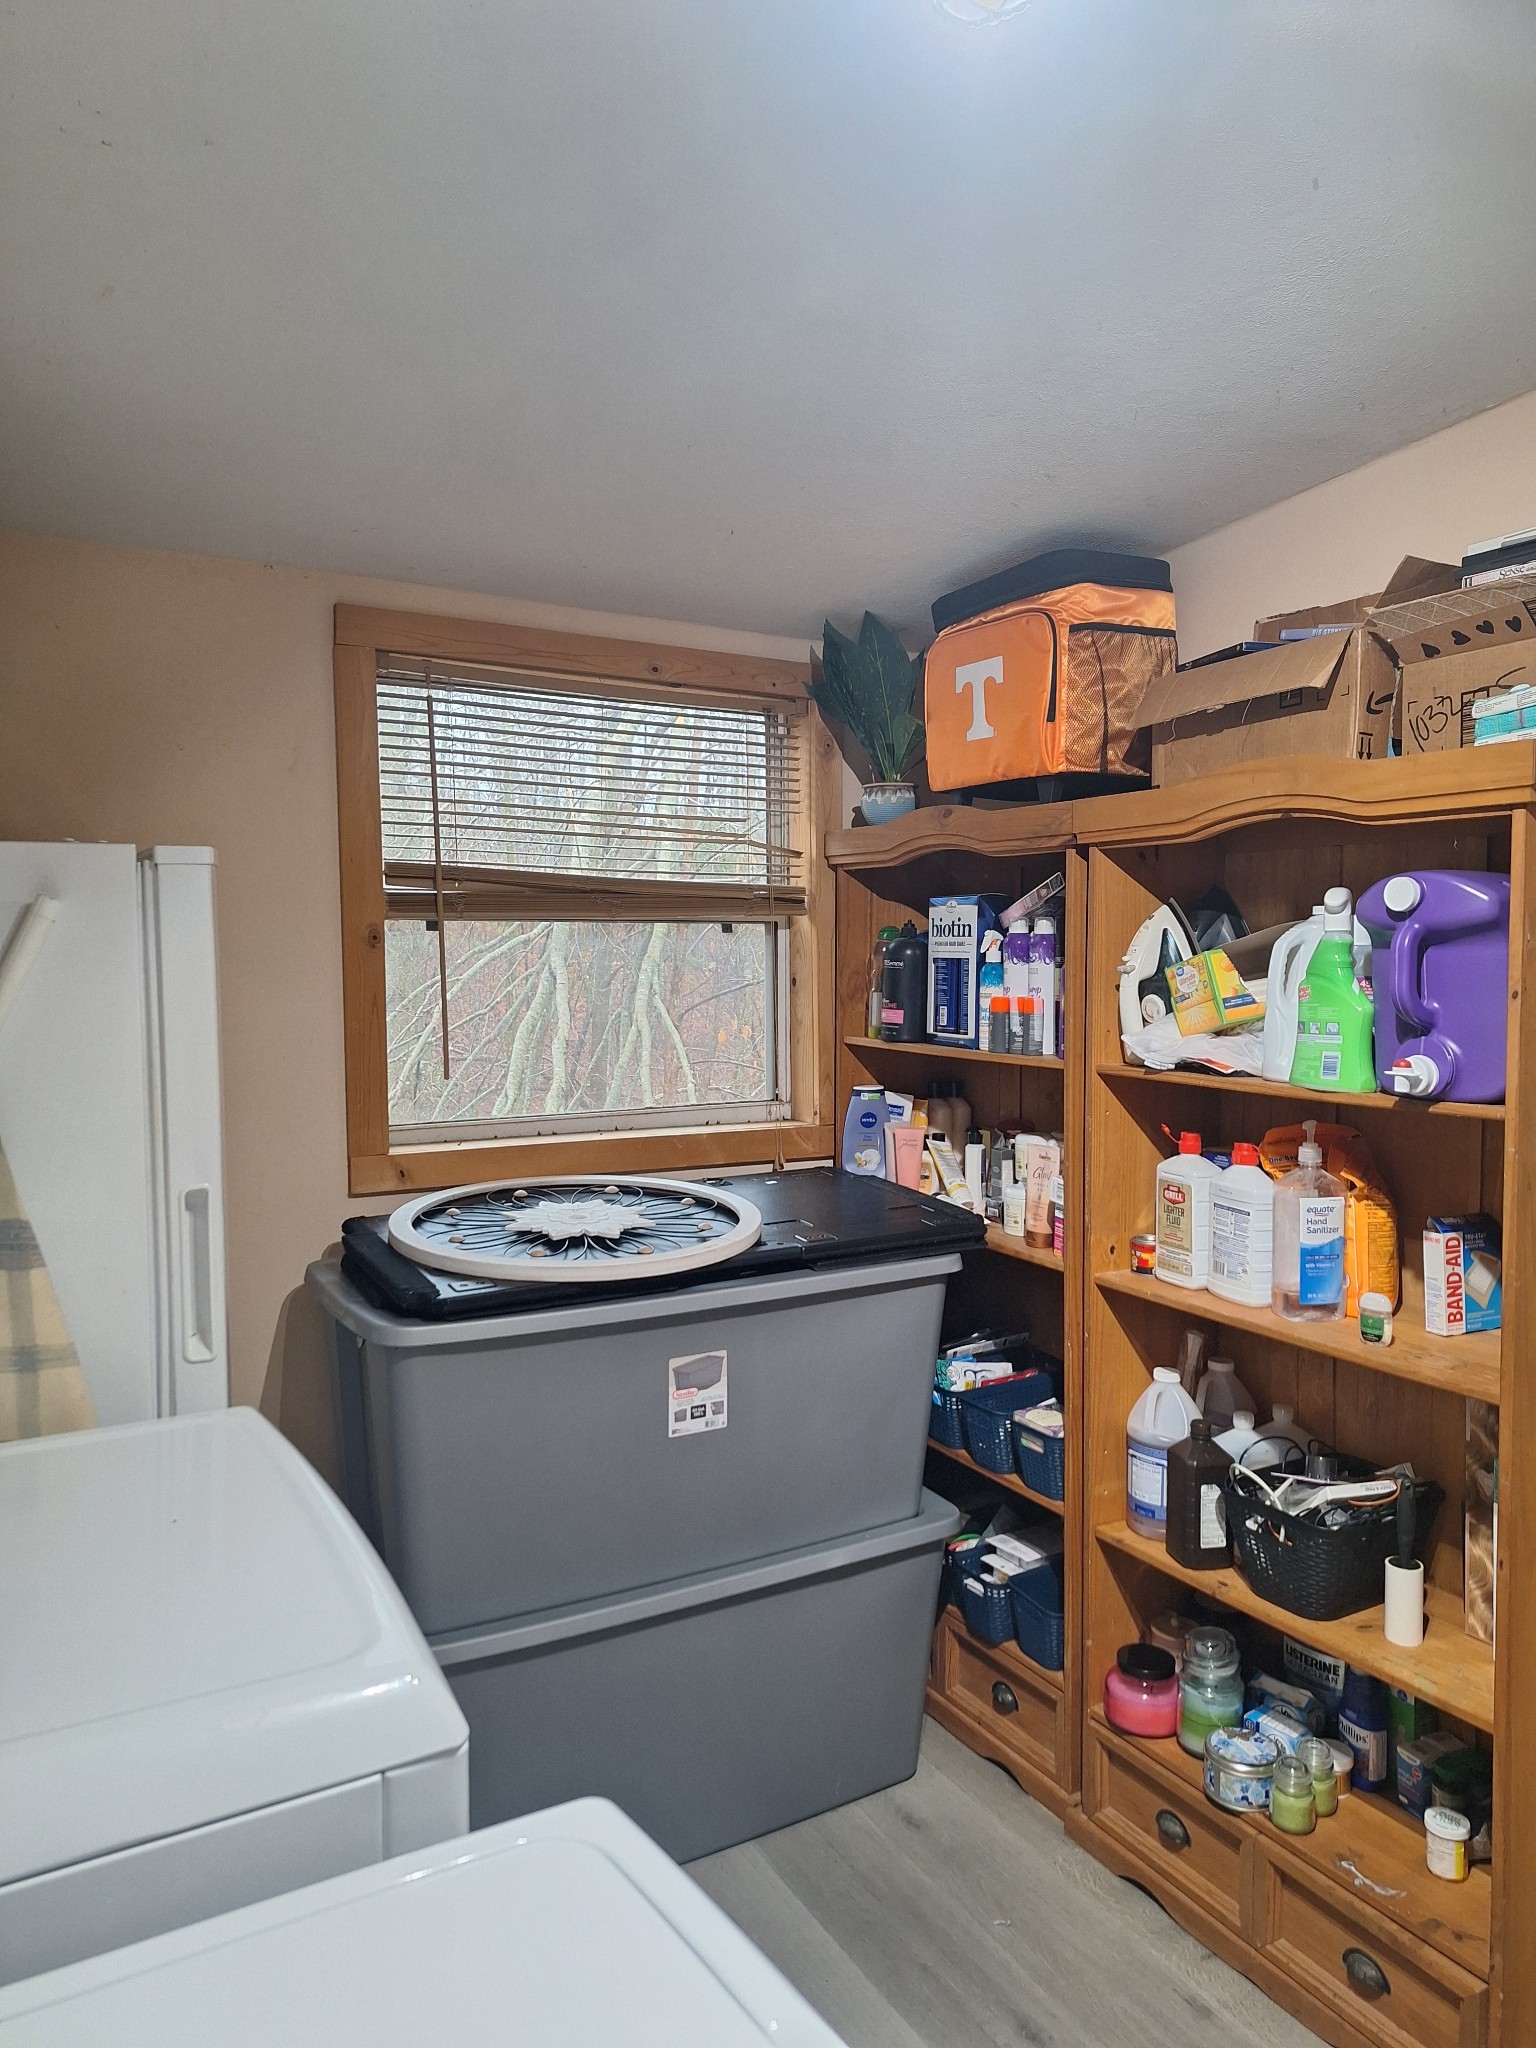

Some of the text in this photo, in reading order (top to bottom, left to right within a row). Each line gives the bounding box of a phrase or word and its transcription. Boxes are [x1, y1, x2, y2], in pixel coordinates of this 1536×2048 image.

[956, 656, 1004, 741] T
[931, 916, 973, 938] biotin
[1163, 1204, 1185, 1218] LIGHTER
[1306, 1205, 1335, 1216] equate
[1166, 1214, 1181, 1226] FLUID
[1306, 1218, 1328, 1226] Hand
[1306, 1226, 1340, 1234] Sanitizer
[1445, 1236, 1463, 1324] BAND-AID
[1285, 1642, 1340, 1676] LISTERINE
